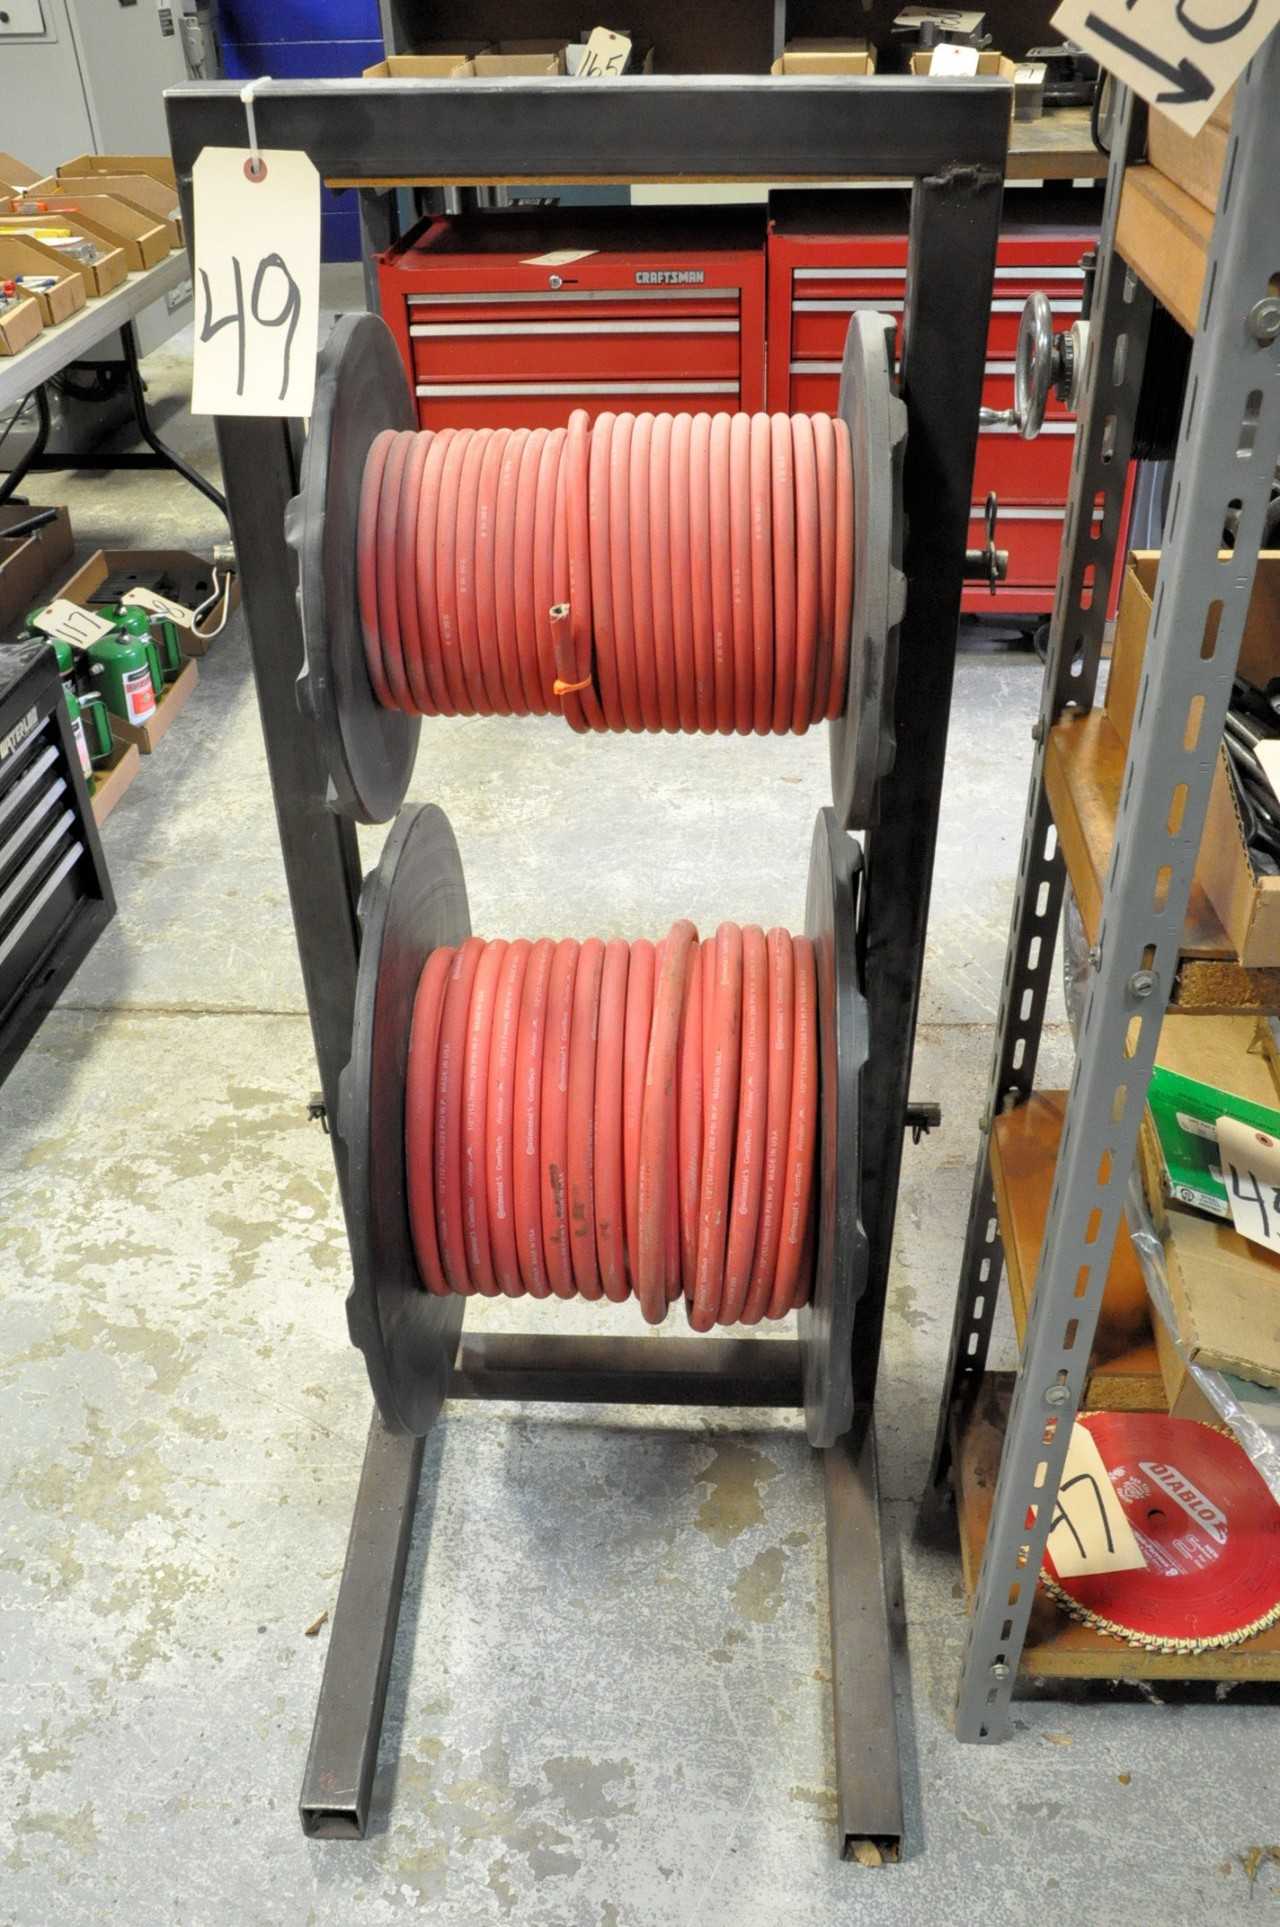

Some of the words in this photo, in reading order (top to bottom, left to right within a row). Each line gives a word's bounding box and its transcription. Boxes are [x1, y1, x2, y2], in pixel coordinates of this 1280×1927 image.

[578, 50, 624, 77] 165
[635, 271, 704, 284] CRAFTSMAN
[198, 252, 302, 401] 49
[56, 611, 102, 645] 117
[1150, 1463, 1217, 1521] DIABLO
